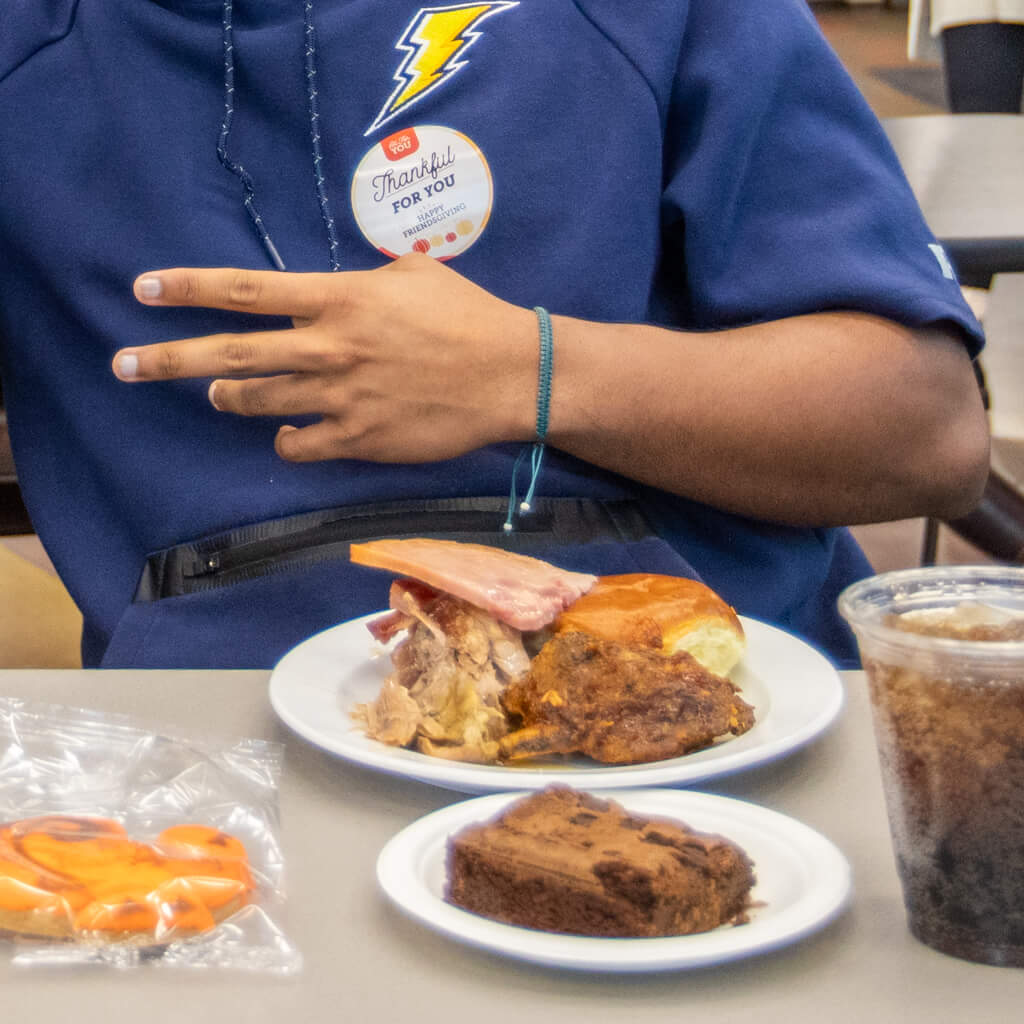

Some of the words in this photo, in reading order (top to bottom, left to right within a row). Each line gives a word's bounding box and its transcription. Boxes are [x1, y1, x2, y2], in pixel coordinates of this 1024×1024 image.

[391, 140, 412, 155] YOU
[372, 145, 456, 202] Thankful
[391, 191, 422, 214] FOR
[424, 174, 456, 198] YOU
[402, 202, 467, 239] FRIENDSGIVING
[416, 204, 445, 223] HAPPY
